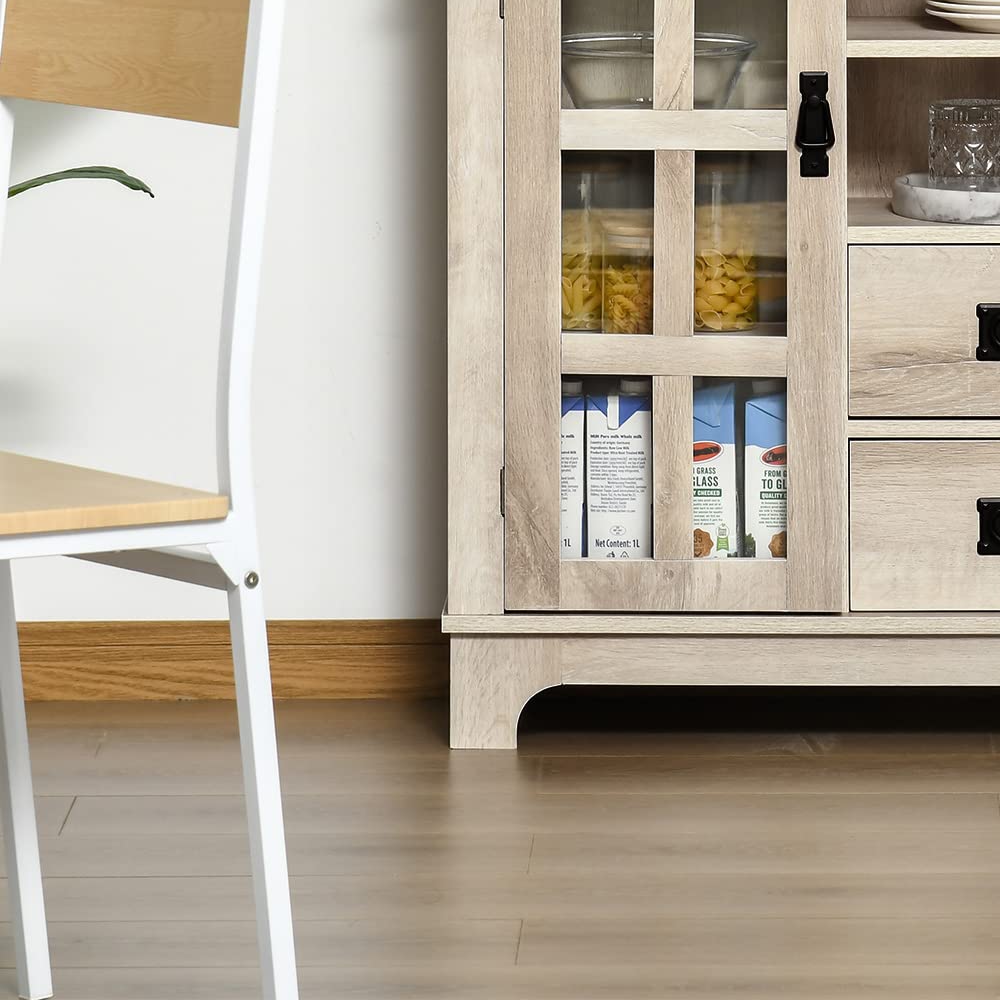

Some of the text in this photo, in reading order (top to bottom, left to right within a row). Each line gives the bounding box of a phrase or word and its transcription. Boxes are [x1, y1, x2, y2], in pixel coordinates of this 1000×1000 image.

[762, 479, 773, 489] TO
[595, 539, 605, 548] Net
[606, 539, 631, 548] Content:
